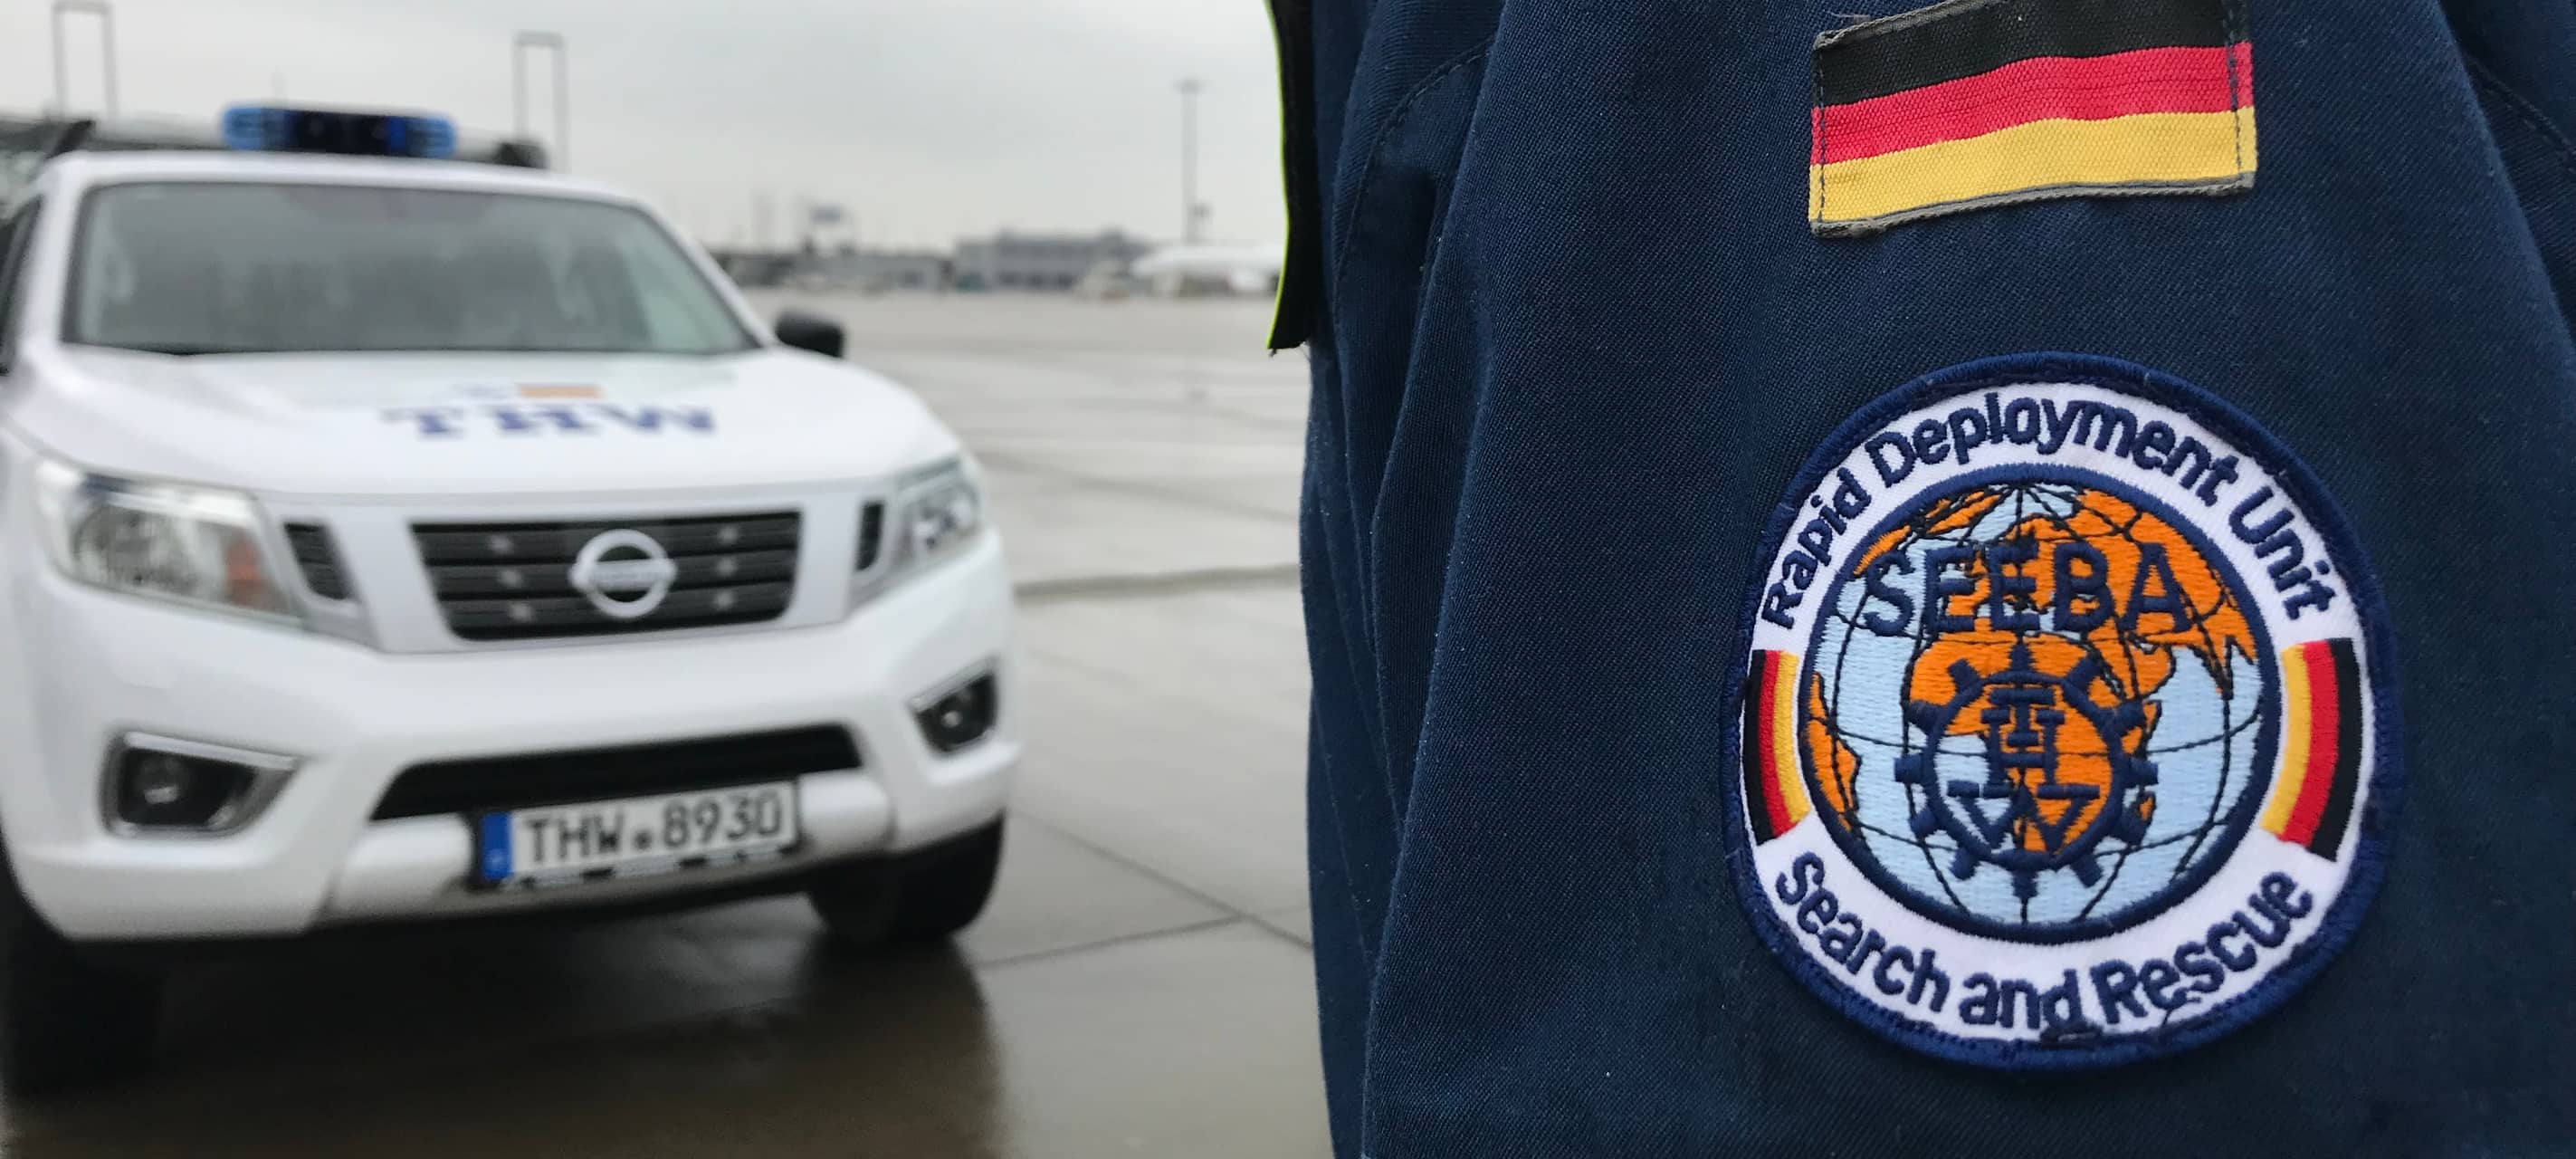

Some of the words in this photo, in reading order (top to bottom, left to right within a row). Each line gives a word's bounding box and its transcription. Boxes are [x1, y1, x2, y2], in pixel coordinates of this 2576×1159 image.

[1765, 467, 1871, 628] Rapid
[1866, 393, 2239, 505] Deployment
[2229, 487, 2335, 620] Unit
[1865, 543, 2187, 637] SEEBA
[1776, 853, 1951, 1012] Search
[1961, 970, 2082, 1035] and
[2093, 872, 2314, 1025] Rescue
